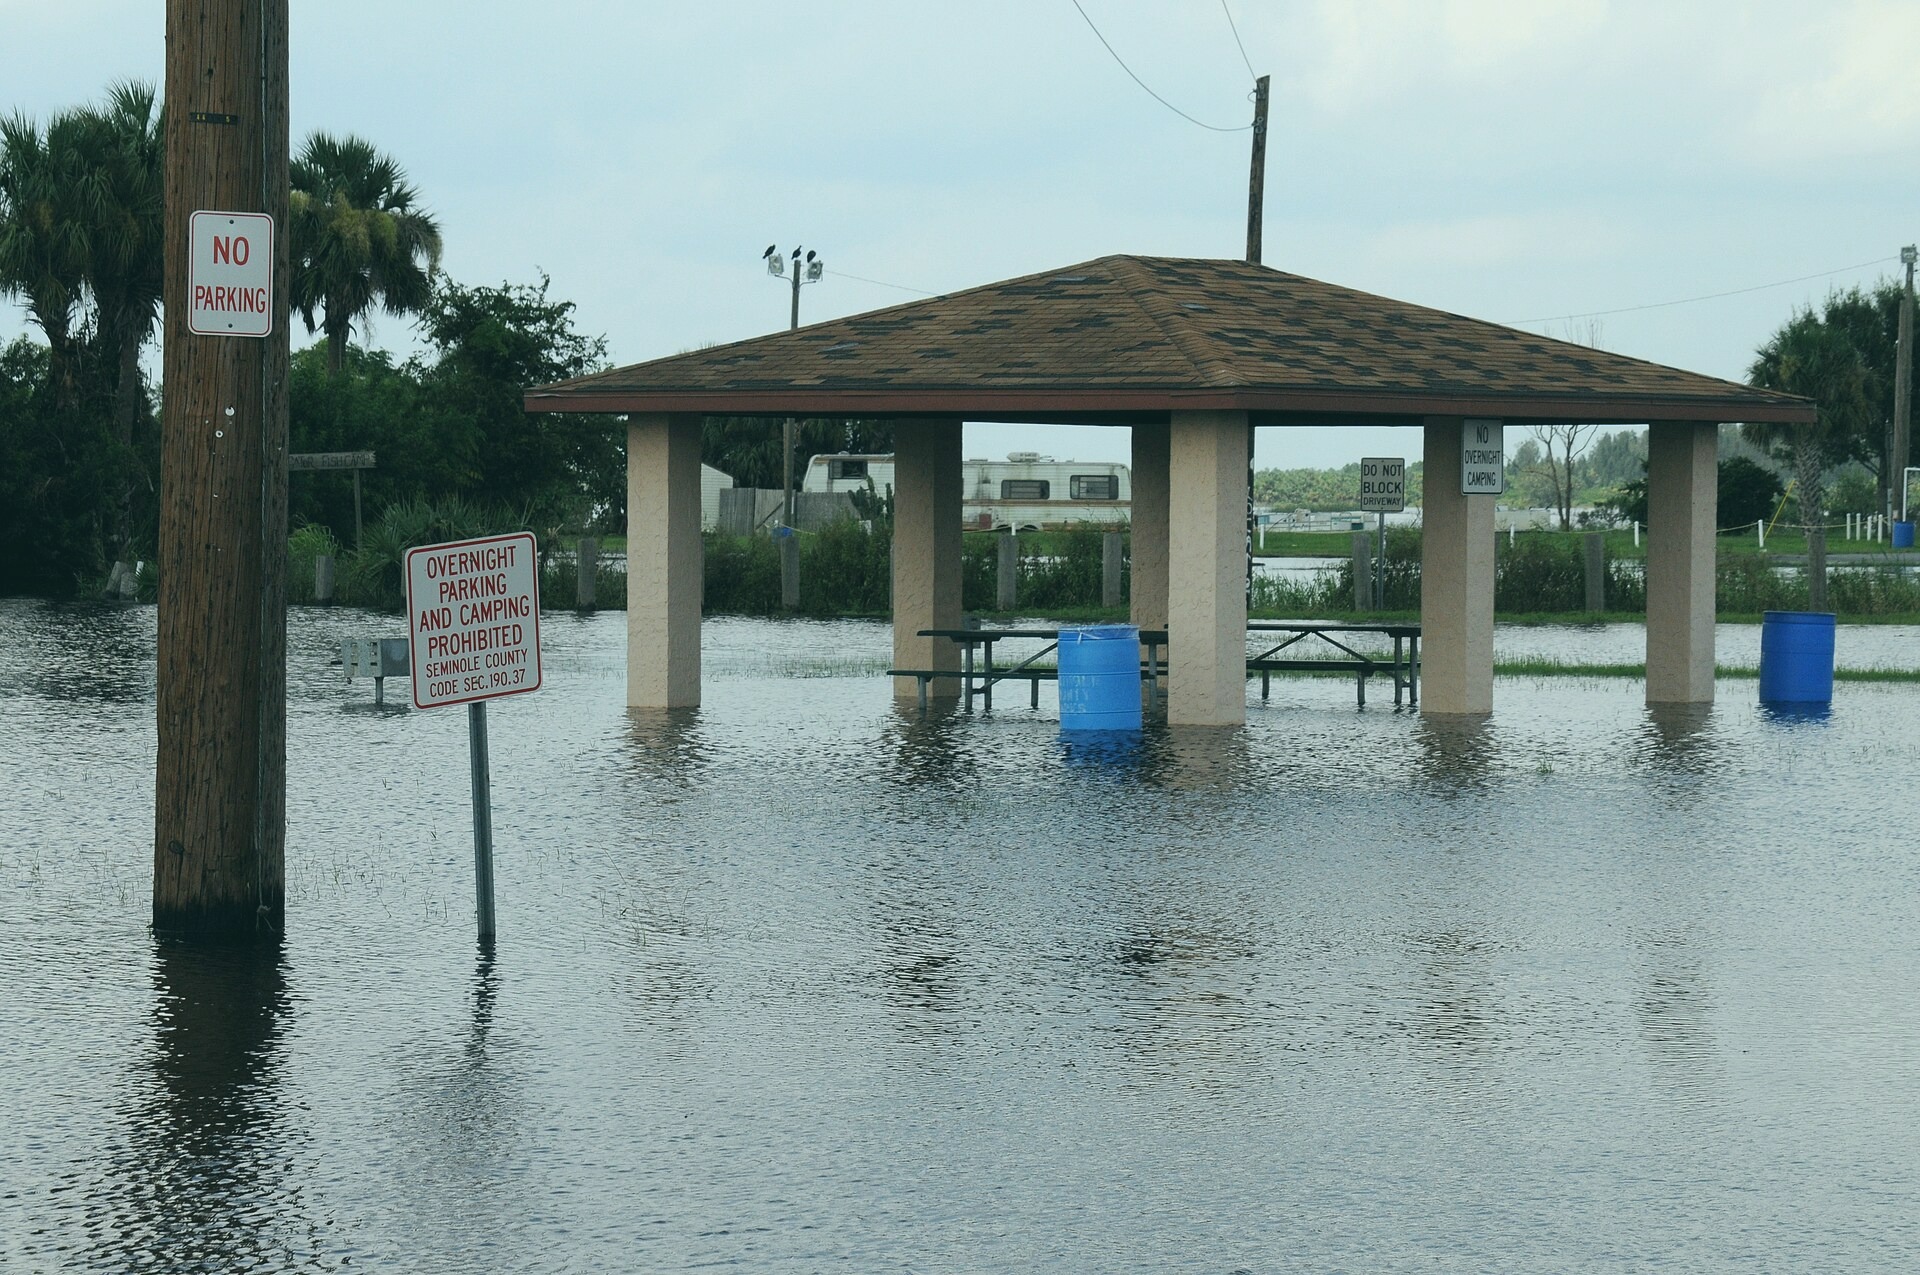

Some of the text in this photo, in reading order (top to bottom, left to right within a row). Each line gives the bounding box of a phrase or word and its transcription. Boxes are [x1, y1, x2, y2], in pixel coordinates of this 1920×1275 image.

[213, 235, 249, 266] NO
[195, 285, 266, 313] PARKING
[1476, 426, 1489, 444] NO
[1464, 450, 1501, 465] OVERNIGHT
[1363, 464, 1402, 477] DO NOT
[1467, 471, 1496, 487] CAMPING
[1363, 481, 1402, 494] BLOCK
[1363, 496, 1401, 506] DRIVEWAY
[427, 545, 516, 579] OVERNIGHT
[439, 573, 507, 603] PARKING
[419, 595, 530, 632] AND CAMPING
[428, 624, 523, 659] PROHIBITED
[426, 648, 528, 678] SEMINOLE COUNTY
[430, 679, 459, 698] CODE
